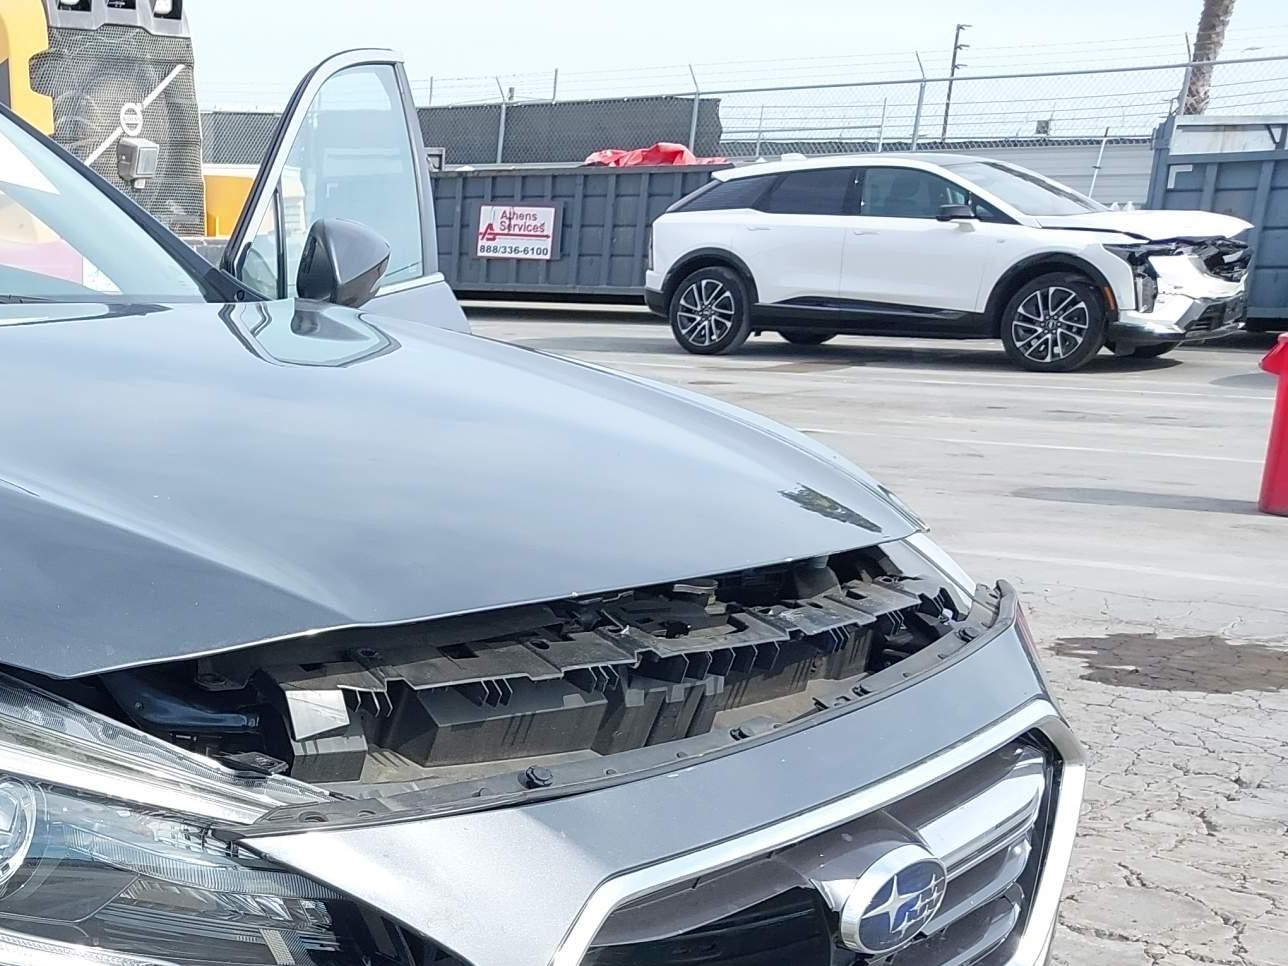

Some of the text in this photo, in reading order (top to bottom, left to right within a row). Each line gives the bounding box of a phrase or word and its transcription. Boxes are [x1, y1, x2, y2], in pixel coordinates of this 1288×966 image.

[500, 209, 538, 221] Athens
[499, 221, 546, 233] Services
[479, 244, 549, 256] 888/336-6100
